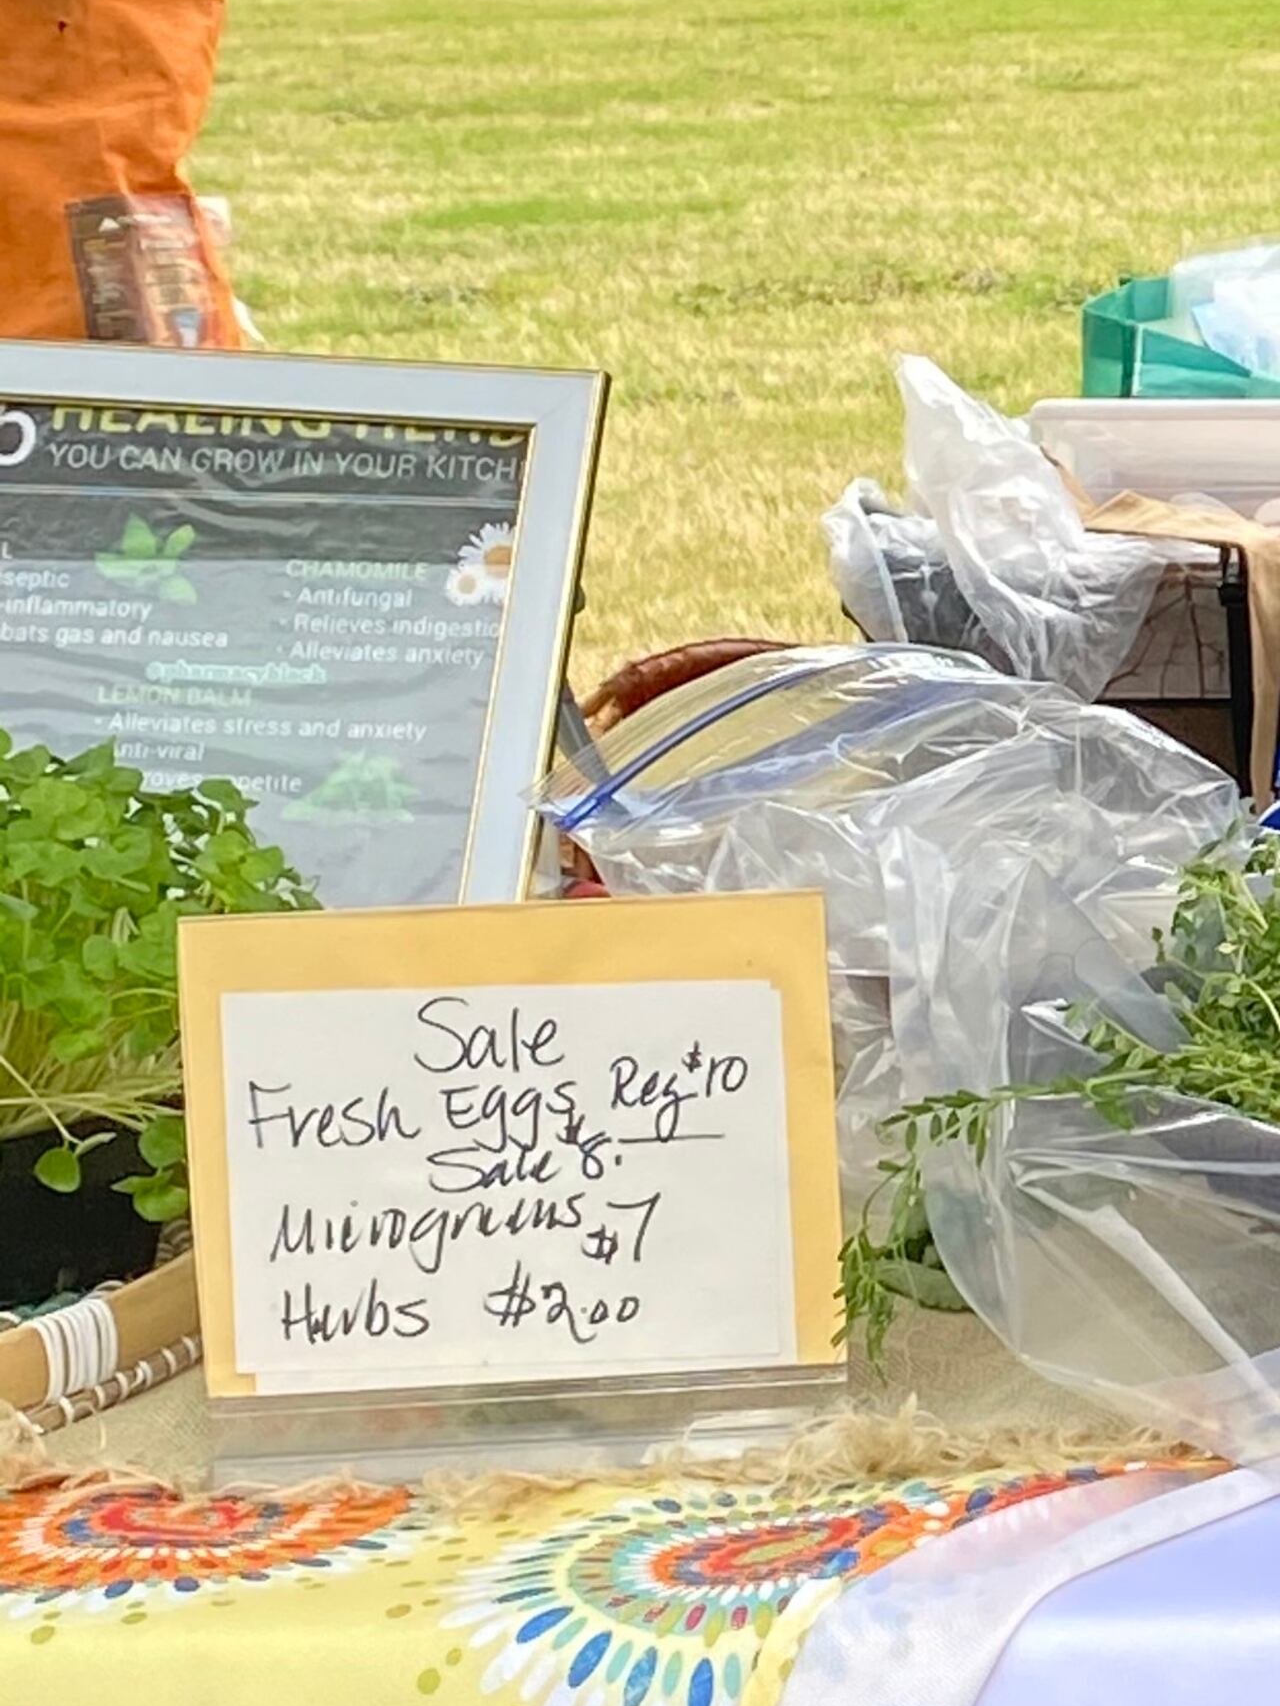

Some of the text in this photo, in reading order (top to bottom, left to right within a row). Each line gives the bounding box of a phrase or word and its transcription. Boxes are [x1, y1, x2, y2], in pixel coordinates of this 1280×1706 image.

[50, 443, 523, 482] YOU CAN GROW IN YOUR KITCH
[286, 559, 429, 581] CHAMOMILE
[297, 587, 412, 612] Antifungal
[55, 627, 96, 648] gas
[101, 625, 143, 645] and
[148, 629, 228, 648] nausea
[294, 614, 502, 640] Relieves indigestio
[289, 641, 485, 672] Alleviates anxiety
[98, 686, 181, 706] LEMON
[108, 712, 428, 743] Alleviates stress and anxiety
[121, 742, 204, 761] nti-viral
[142, 770, 302, 792] roves petite
[413, 997, 565, 1073] Sale
[248, 1081, 421, 1149] Fresh
[439, 1080, 579, 1153] Eggs
[426, 1141, 561, 1193] Sale
[582, 1193, 661, 1263] $7
[281, 1260, 641, 1344] Herbs $2.00
